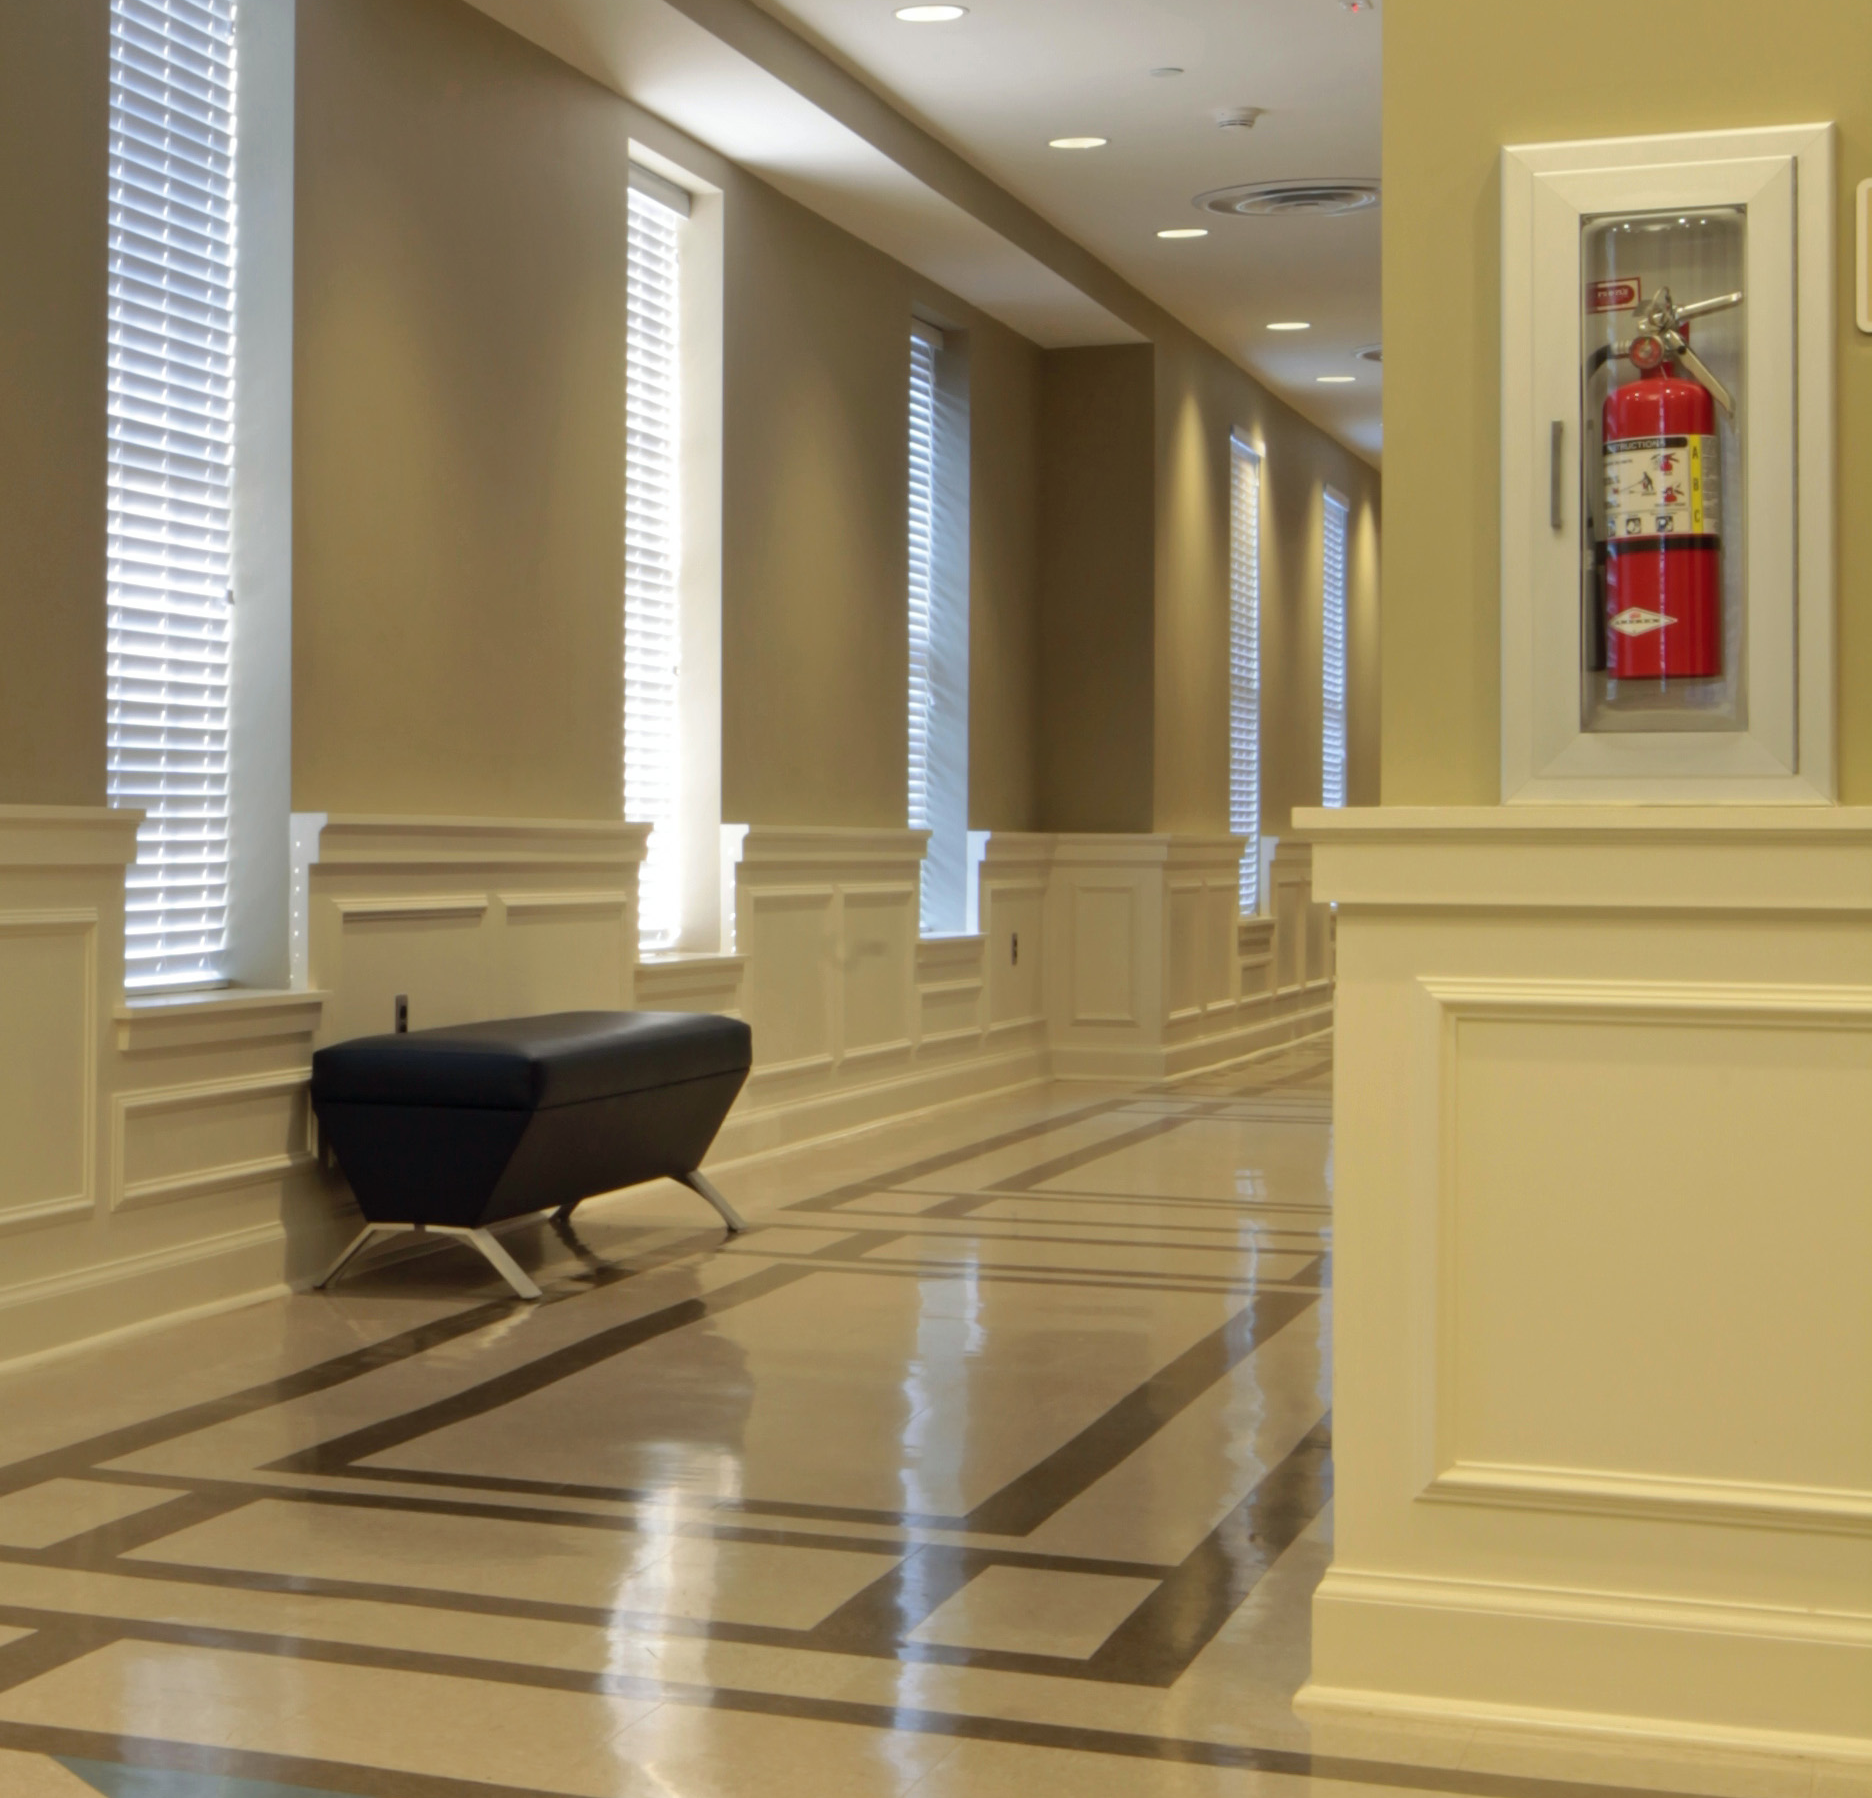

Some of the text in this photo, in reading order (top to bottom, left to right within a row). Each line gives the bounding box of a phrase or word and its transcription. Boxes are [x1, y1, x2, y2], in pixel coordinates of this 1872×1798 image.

[1692, 446, 1699, 459] A
[1693, 478, 1699, 491] B
[1694, 509, 1700, 523] C
